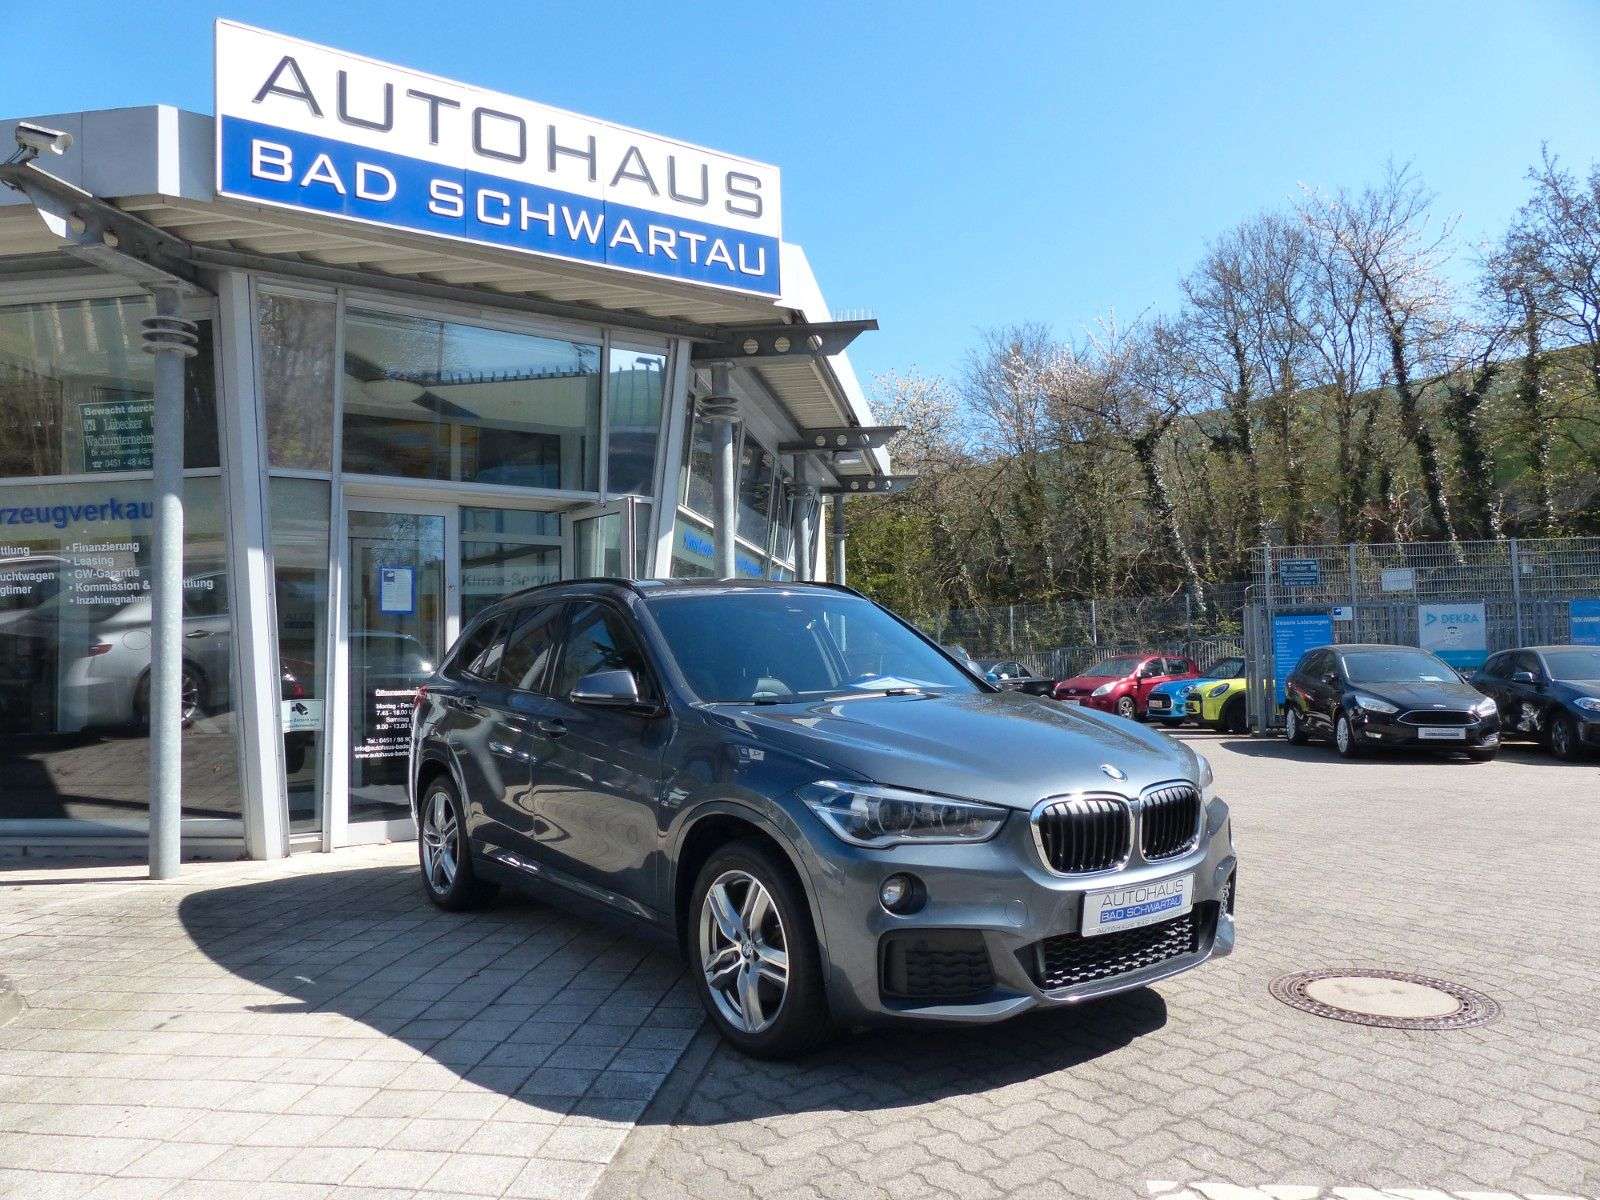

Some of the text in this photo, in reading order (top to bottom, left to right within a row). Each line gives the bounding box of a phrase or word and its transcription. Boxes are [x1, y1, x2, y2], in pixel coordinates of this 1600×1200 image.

[252, 55, 763, 219] AUTOHAUS
[251, 139, 766, 277] BAD SCHWARTAU
[72, 541, 140, 554] Finanzierung
[73, 555, 115, 567] Leasing
[74, 568, 140, 580] GW-Garantie
[75, 581, 140, 593] Kommission
[1441, 612, 1480, 624] DEKRA
[1101, 880, 1184, 908] AUTOHAUS
[1101, 896, 1182, 922] BAD SCHWARTAU
